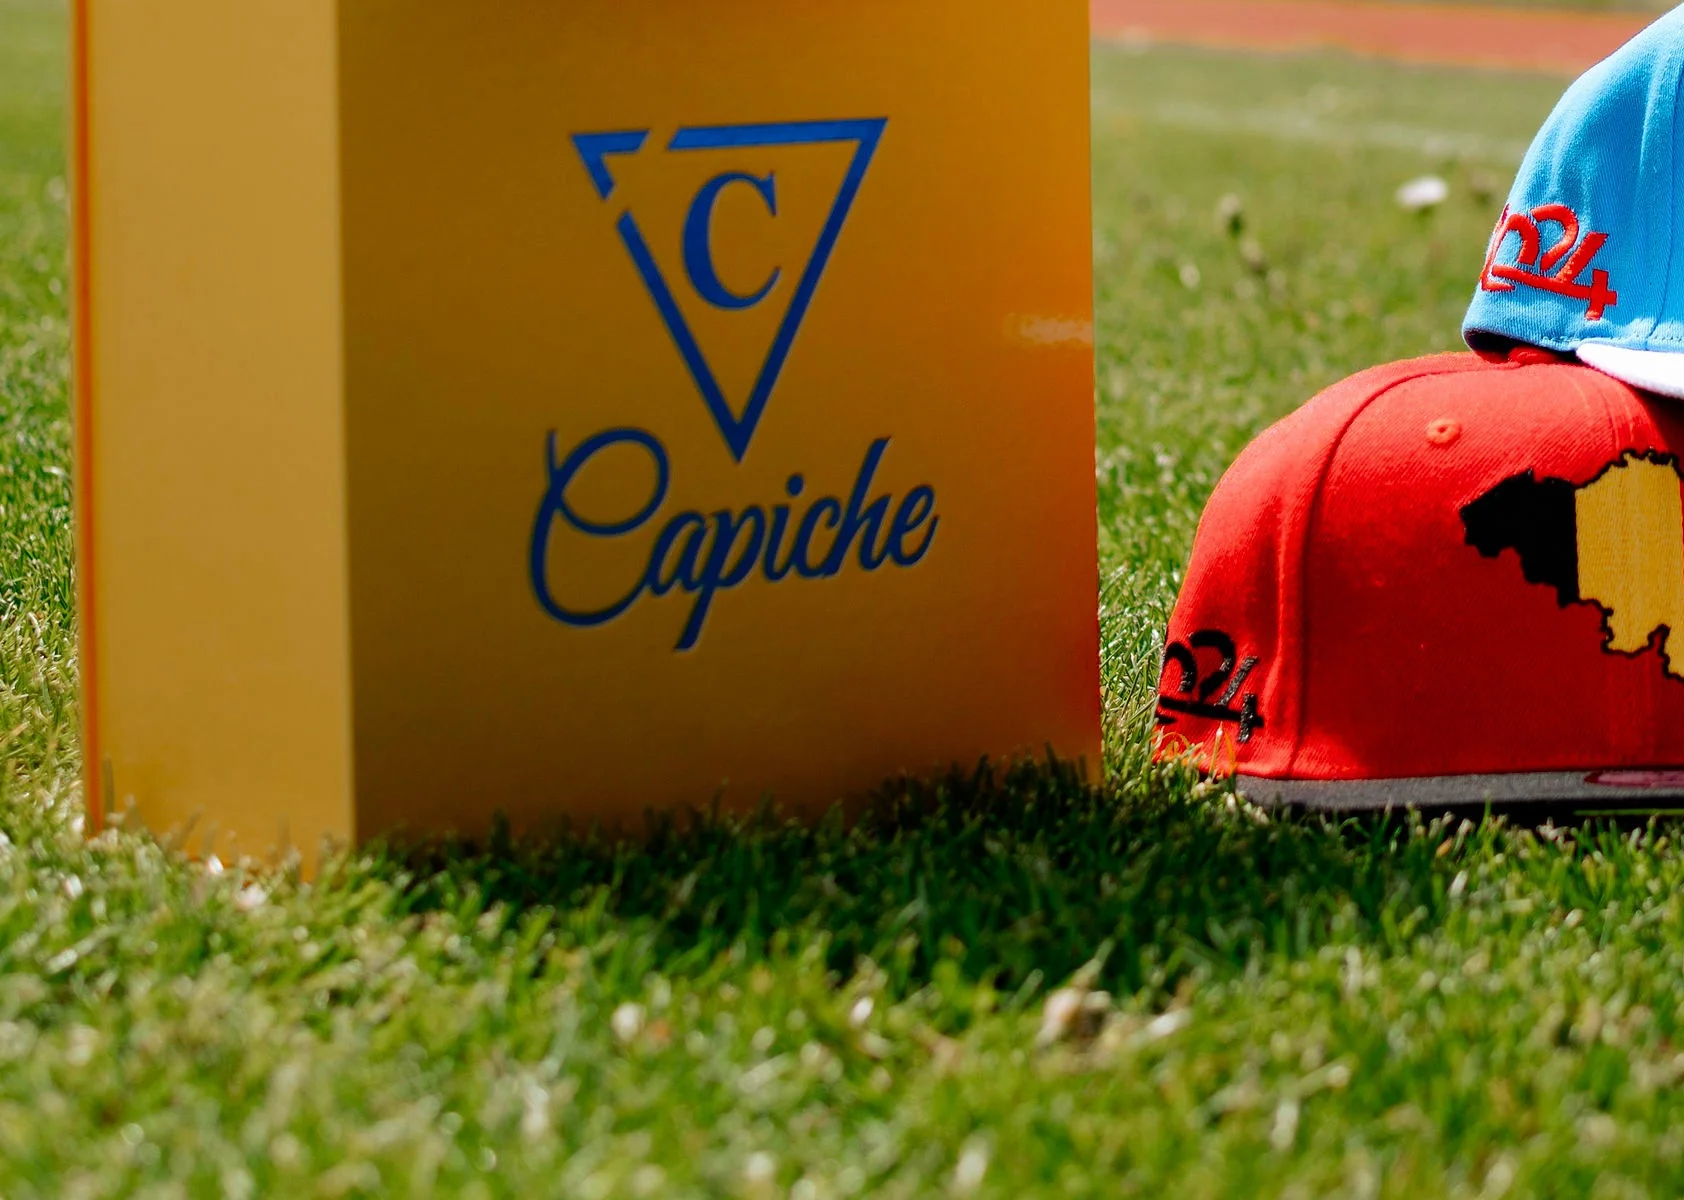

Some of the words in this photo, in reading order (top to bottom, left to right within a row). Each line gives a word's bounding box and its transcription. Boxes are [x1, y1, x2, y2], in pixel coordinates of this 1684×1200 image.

[680, 169, 782, 311] C
[527, 425, 939, 653] Capiche
[1154, 627, 1265, 744] 024
